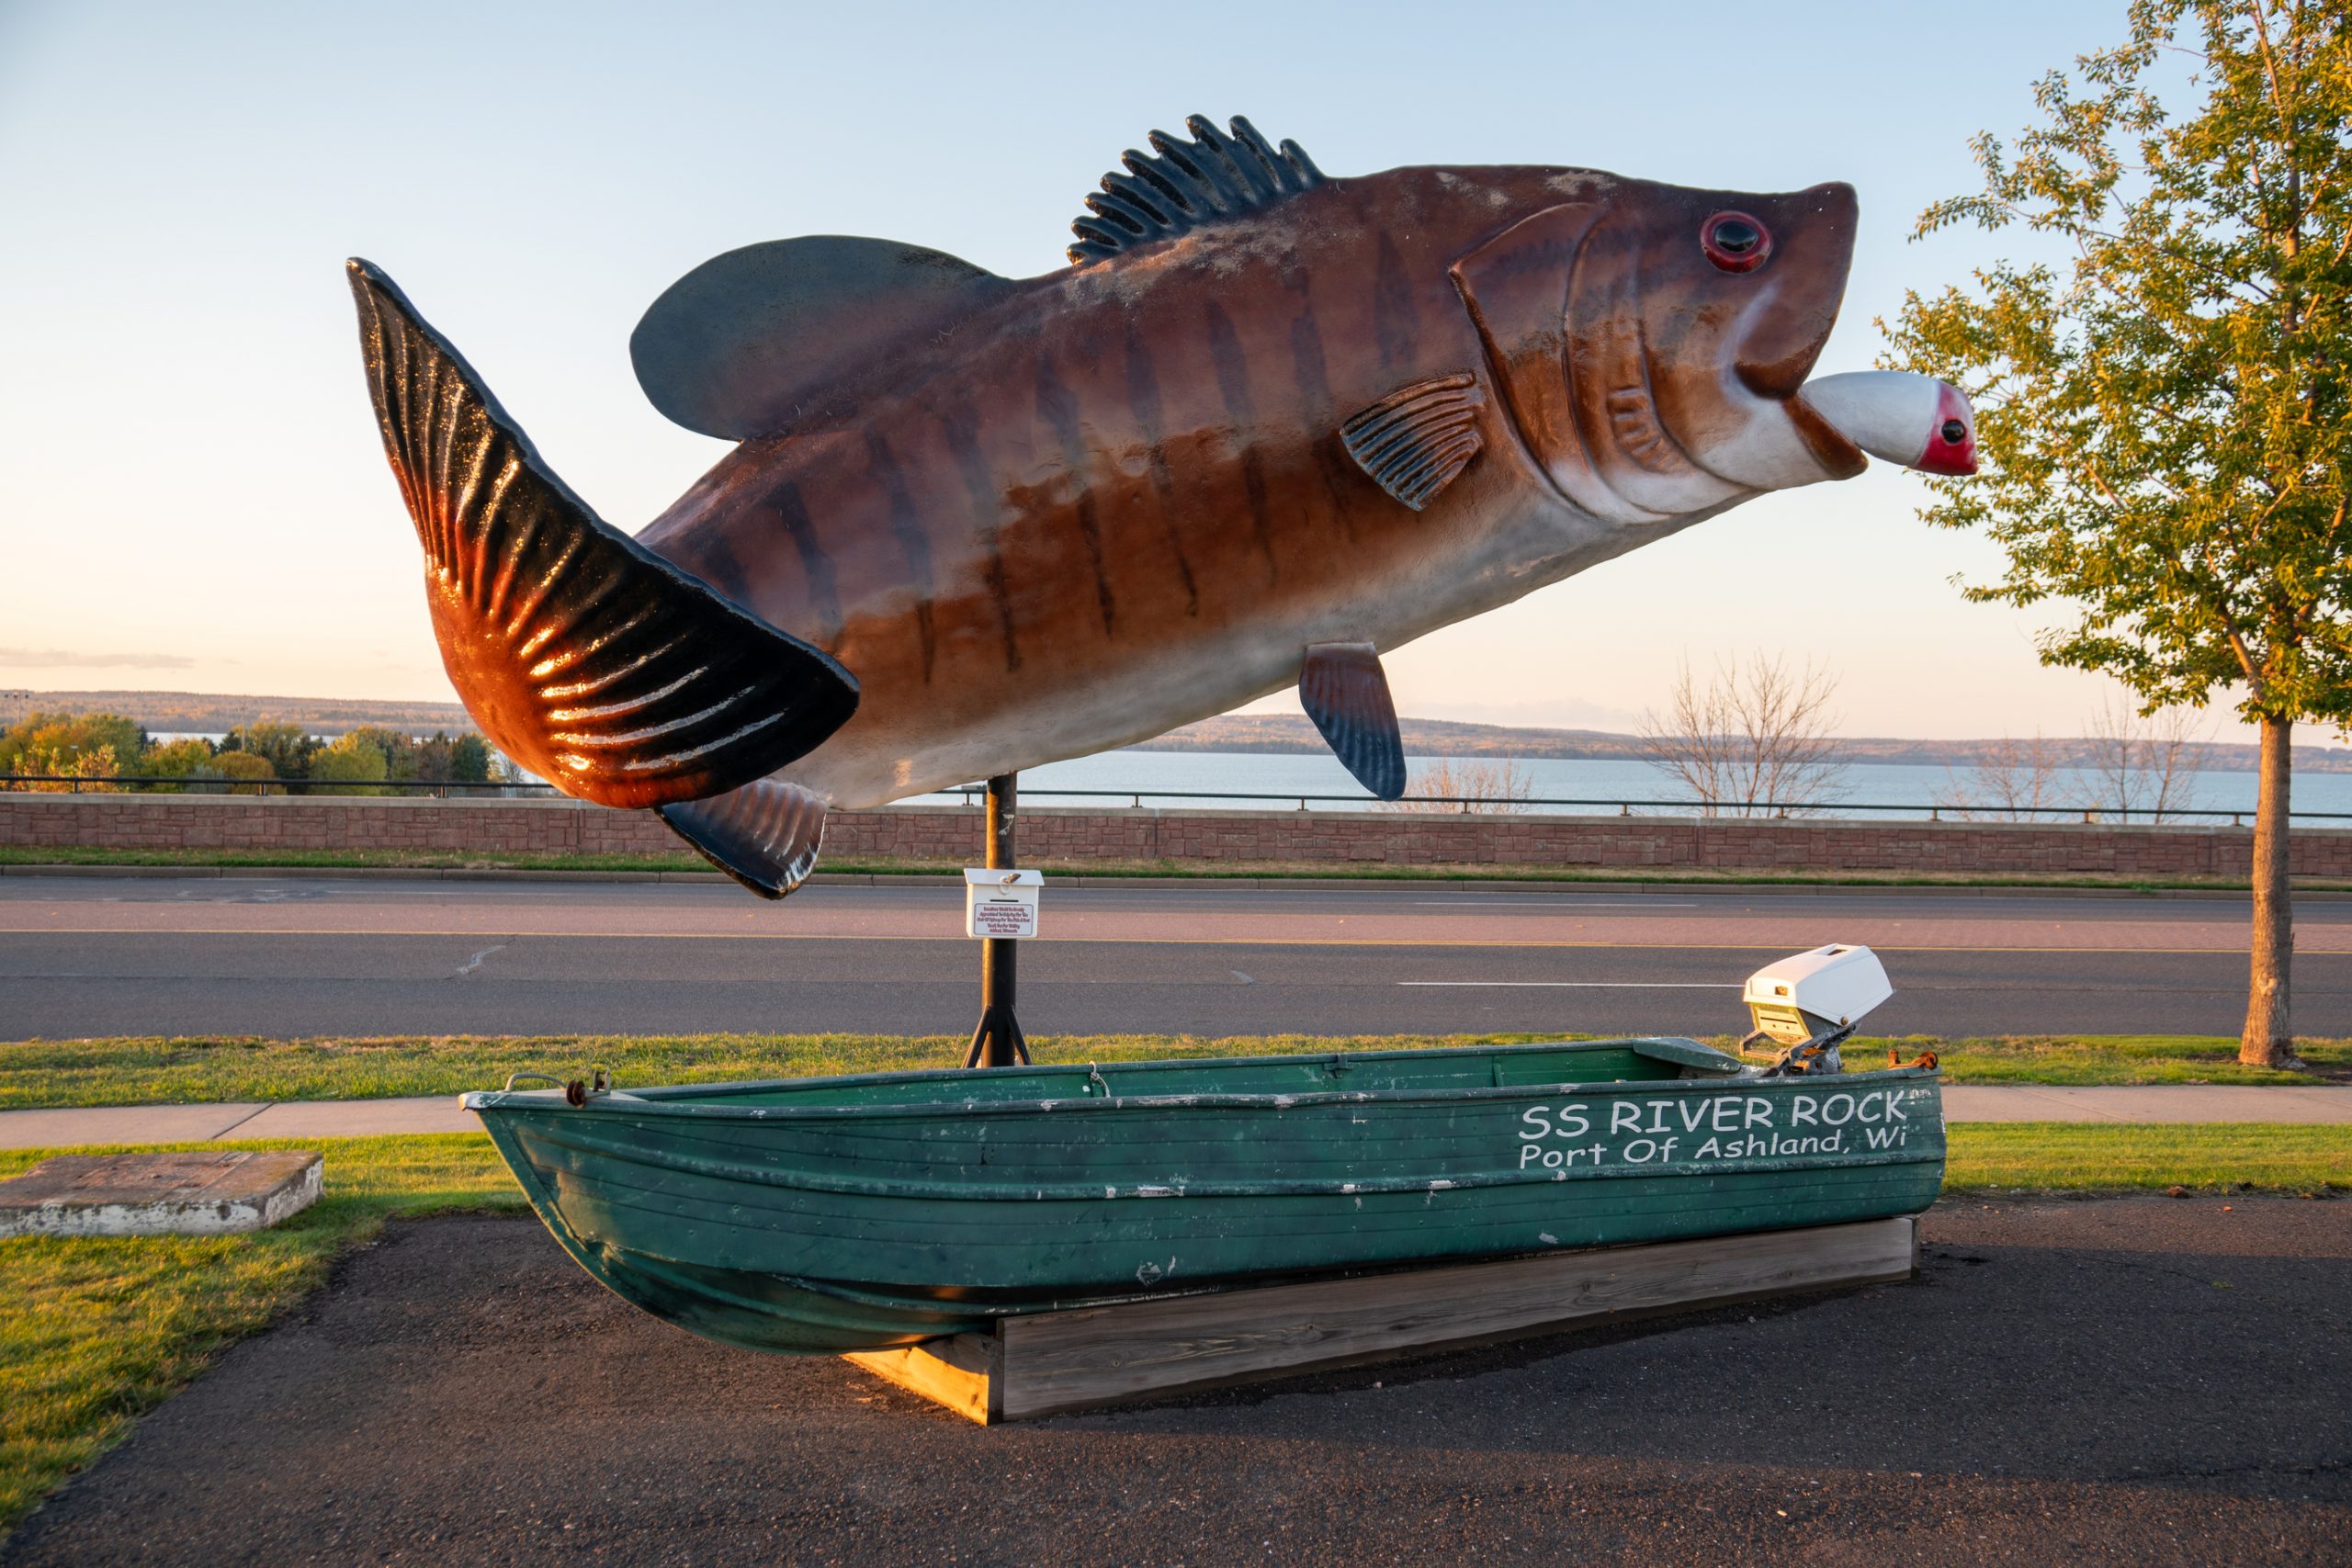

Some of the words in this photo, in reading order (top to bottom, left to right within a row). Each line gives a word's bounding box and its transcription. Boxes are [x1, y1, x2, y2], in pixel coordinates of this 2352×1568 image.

[1518, 1104, 1590, 1140] SS
[1611, 1096, 1773, 1135] RIVER
[1792, 1089, 1909, 1127] ROCK
[1519, 1143, 1608, 1169] Port
[1623, 1136, 1679, 1163] Of
[1694, 1129, 1850, 1159] Ashland,
[1866, 1126, 1908, 1149] Wi
